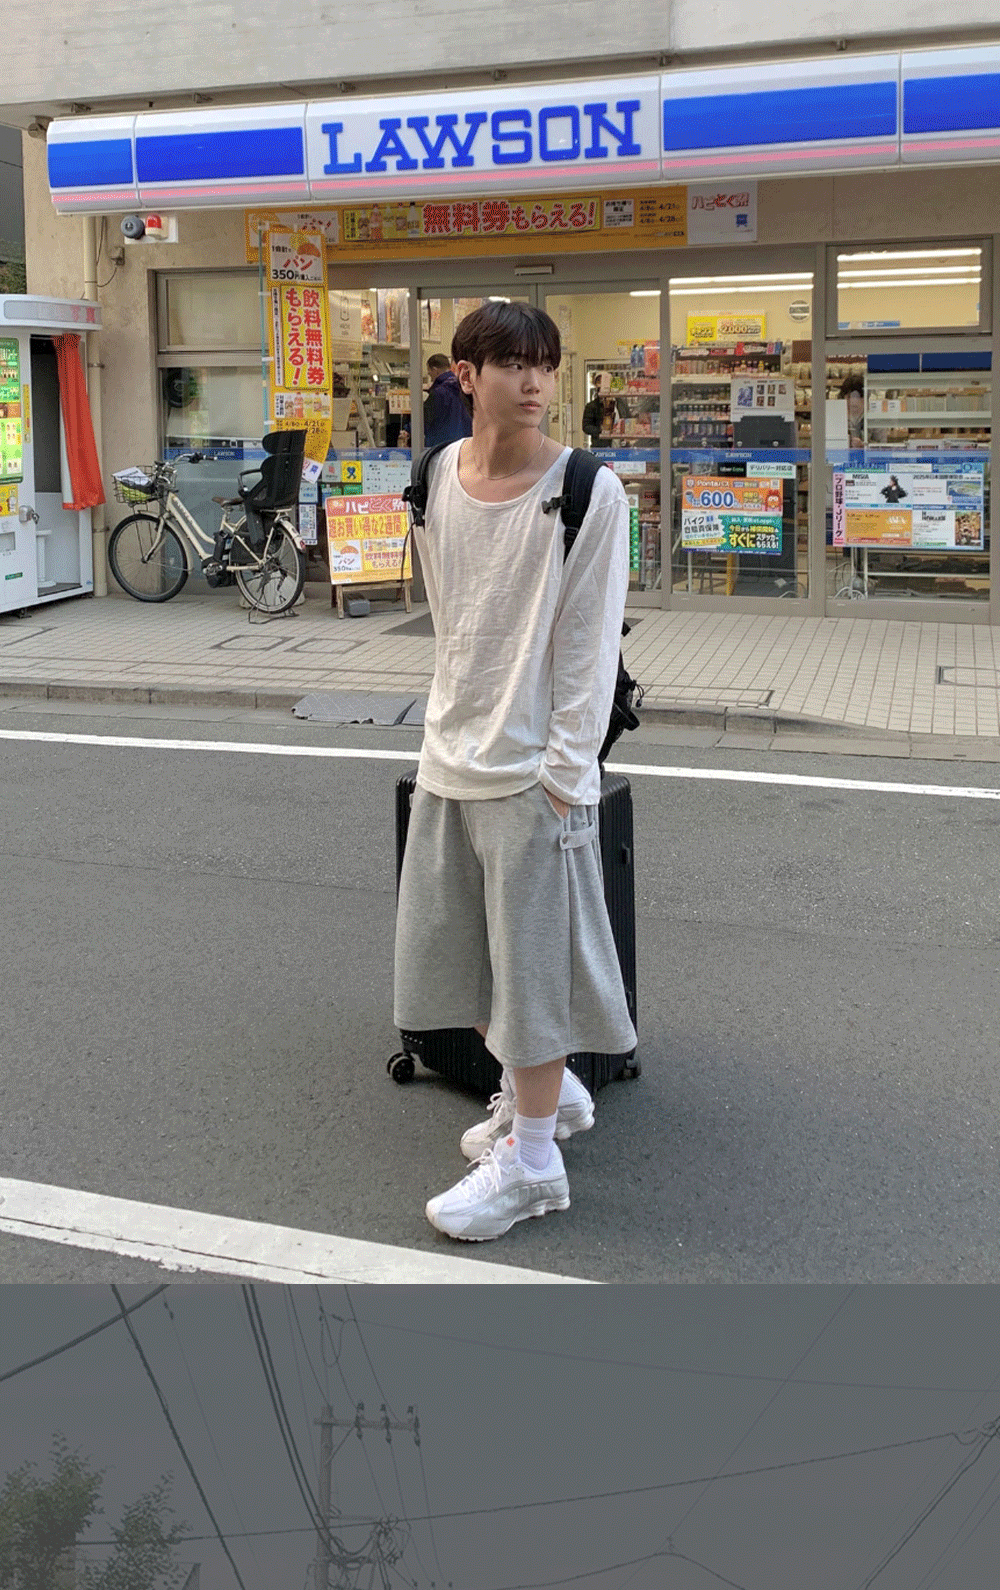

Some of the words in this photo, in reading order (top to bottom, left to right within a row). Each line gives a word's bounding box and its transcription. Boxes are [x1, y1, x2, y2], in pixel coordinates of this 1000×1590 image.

[321, 99, 642, 175] LAWSON
[421, 199, 597, 236] 無料券もらえる!
[303, 289, 325, 385] 飲料無料券
[700, 490, 734, 508] 600
[729, 533, 756, 548] すぐに
